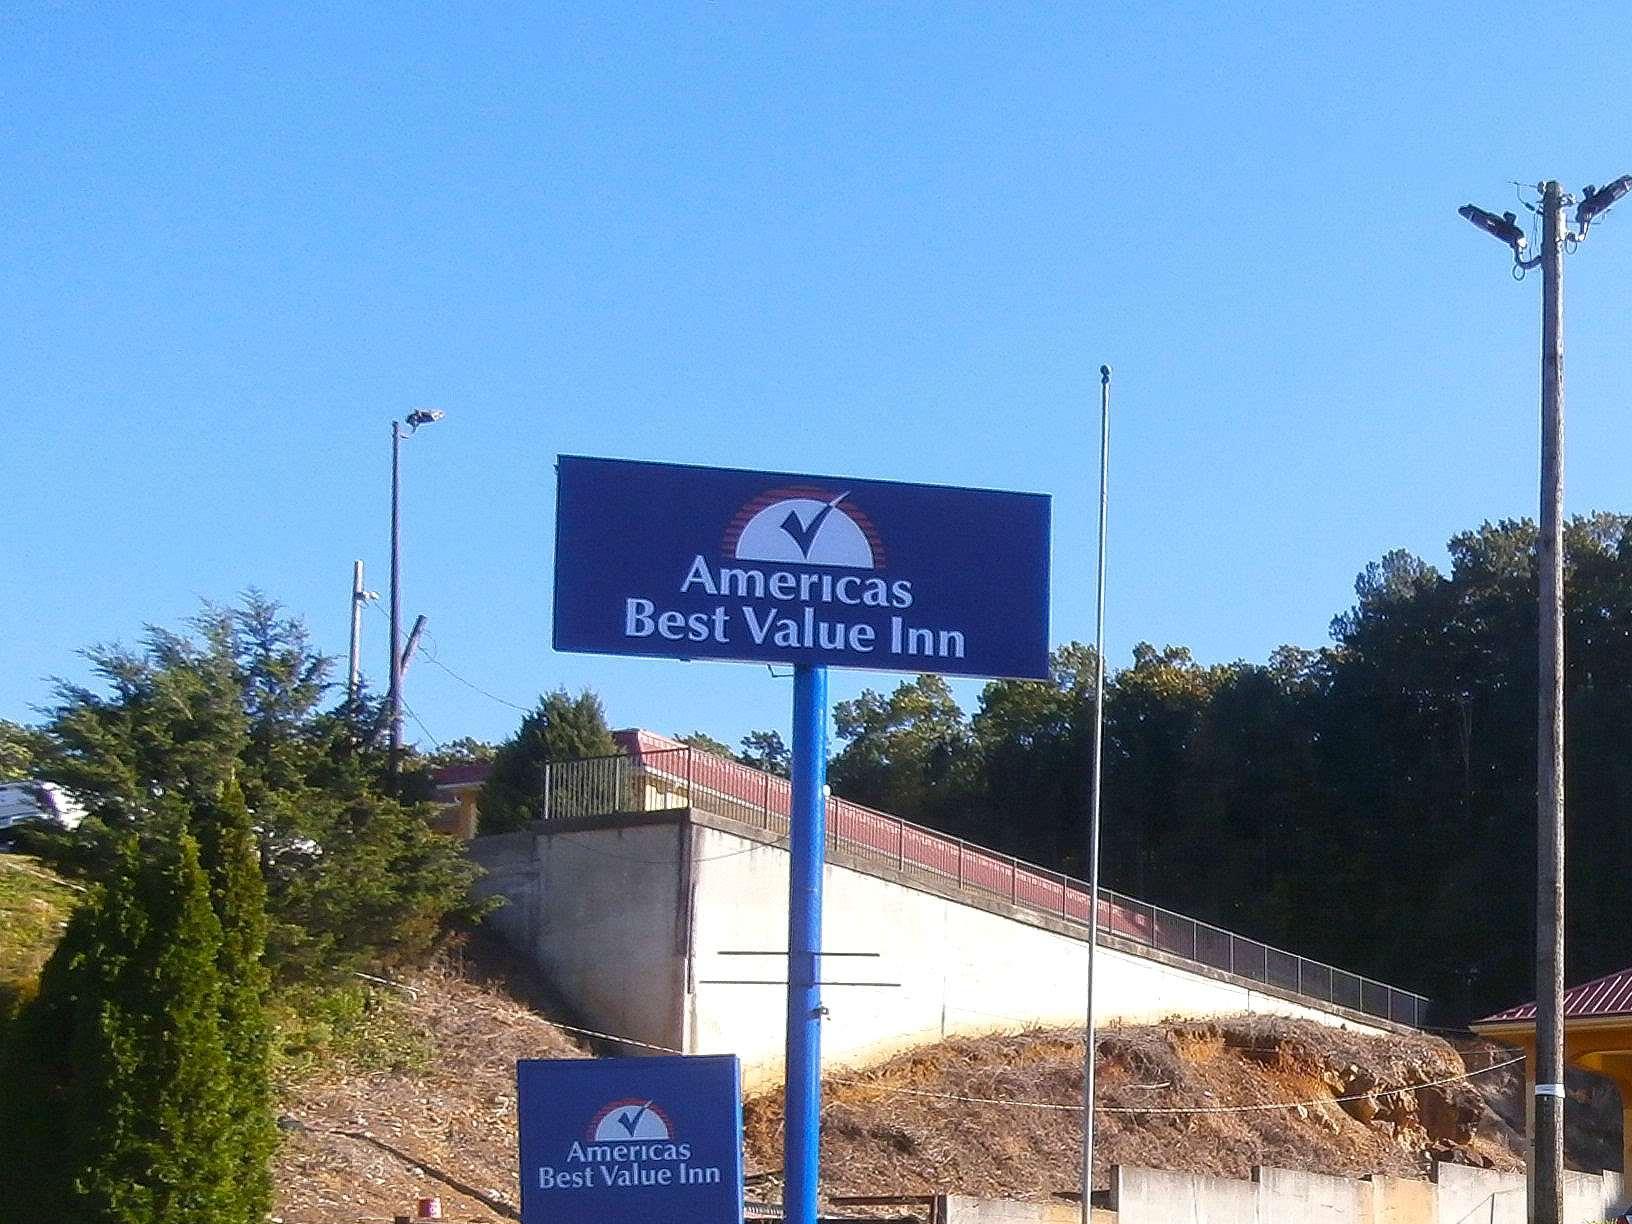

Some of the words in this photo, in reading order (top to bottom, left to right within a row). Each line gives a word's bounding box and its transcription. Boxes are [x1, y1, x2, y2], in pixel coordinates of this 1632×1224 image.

[681, 556, 913, 608] Americas
[625, 598, 730, 641] Best
[742, 607, 875, 652] Value
[890, 616, 966, 658] Inn
[567, 1141, 692, 1162] Americas
[539, 1167, 594, 1188] Best
[600, 1164, 673, 1186] Value
[679, 1163, 721, 1184] Inn
